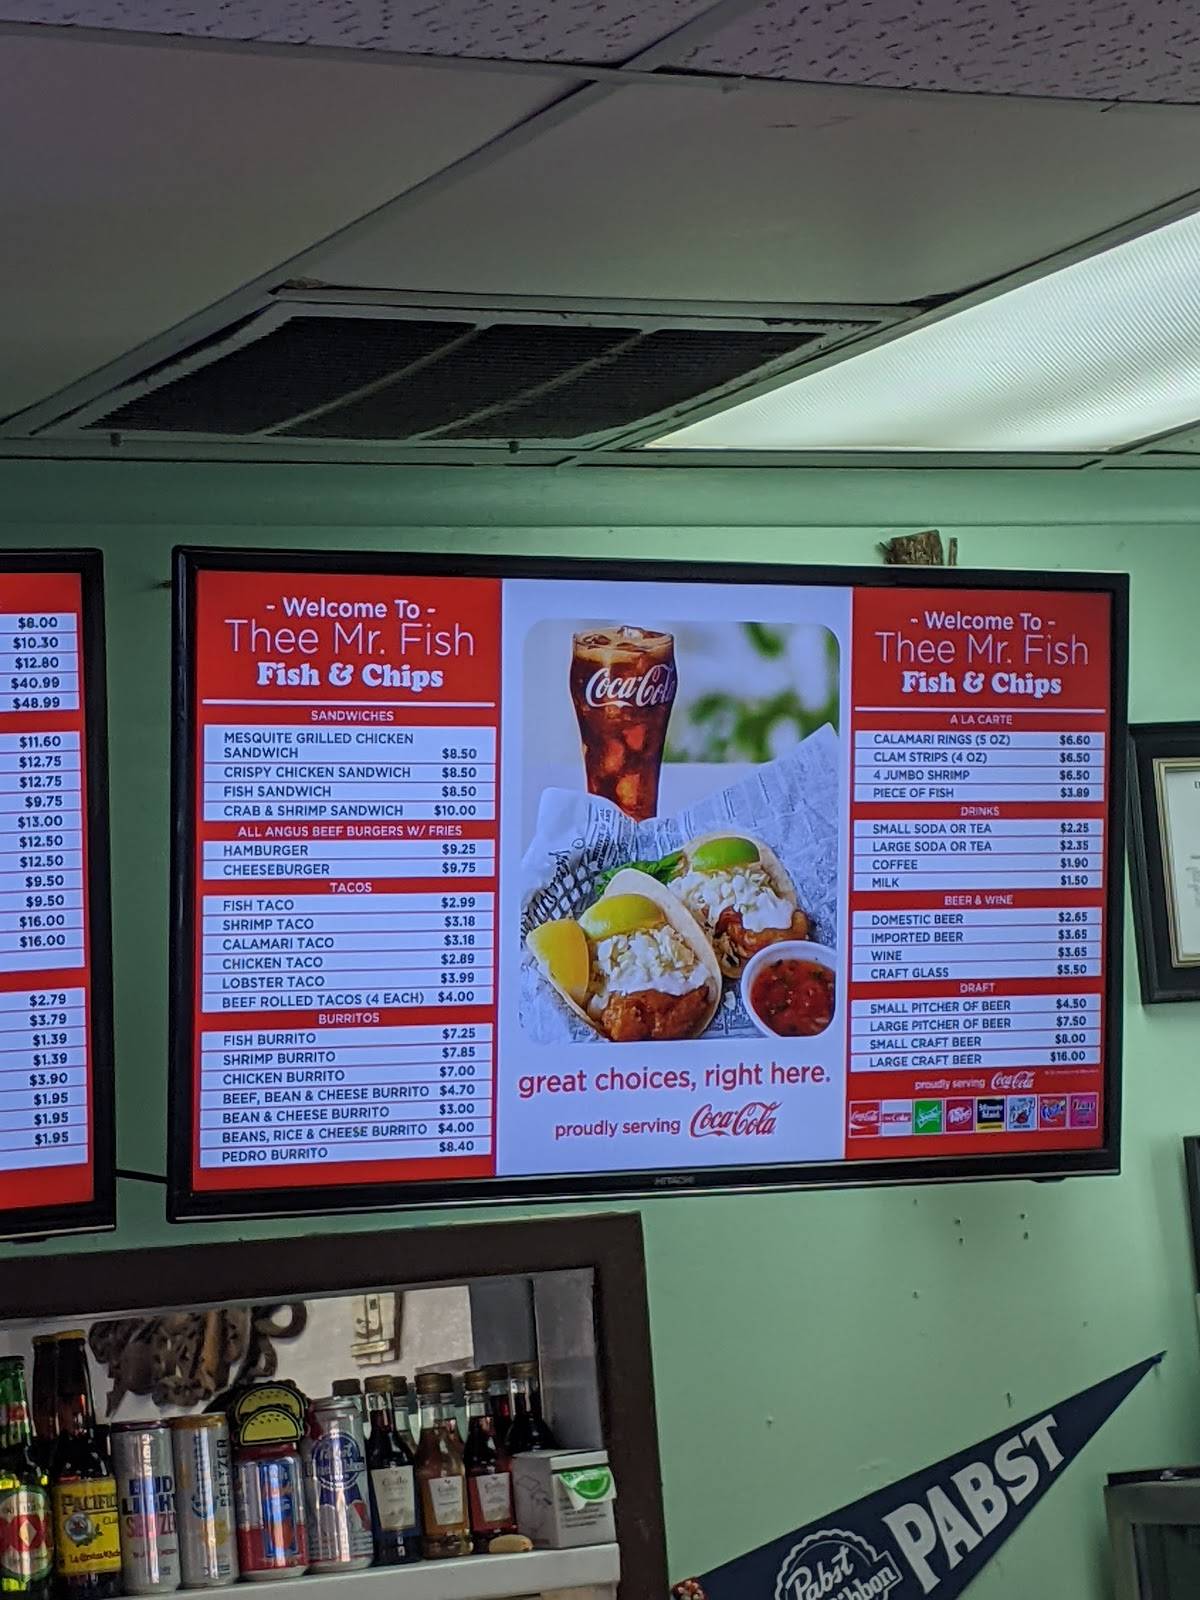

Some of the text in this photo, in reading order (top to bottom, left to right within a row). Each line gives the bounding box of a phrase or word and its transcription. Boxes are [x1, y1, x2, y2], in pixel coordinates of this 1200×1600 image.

[282, 597, 420, 618] Welcome To
[18, 617, 58, 629] $8.00
[925, 611, 1042, 630] Welcome To
[13, 637, 58, 650] $10.30
[224, 618, 474, 656] Thee Mr. Fish
[874, 631, 1089, 665] Thee Mr. Fish
[15, 657, 59, 669] $12.80
[11, 677, 60, 690] $40.99
[256, 662, 444, 692] Fish & Chips
[902, 671, 1062, 698] Fish & Chips
[12, 697, 60, 710] $48.99
[311, 710, 394, 721] SANDWICHES
[950, 715, 1013, 725] A LA CARTE
[19, 736, 61, 749] $11.60
[224, 732, 414, 745] MESQUITE GRILLED CHICKEN
[874, 735, 934, 745] CALAMARI
[938, 735, 972, 745] RINGS
[975, 735, 987, 746] (5
[990, 735, 1010, 746] OZ)
[224, 748, 477, 760] SANDWICH $8.50
[19, 756, 62, 768] $12.75
[224, 766, 476, 778] CRISPY CHICKEN SANDWICH $8.50
[874, 788, 906, 797] PIECE
[909, 788, 926, 797] OF
[929, 788, 954, 797] FISH
[25, 796, 62, 809] $9.75
[224, 805, 476, 816] CRAB & SHRIMP SANDWICH $10.00
[961, 807, 999, 816] DRINKS
[18, 816, 63, 829] $13.00
[873, 824, 911, 834] SMALL
[914, 824, 946, 834] SODA
[950, 824, 967, 834] OR
[970, 824, 992, 833] TEA
[238, 826, 462, 838] ALL ANGUS BEEF BURGERS W/ FRIES
[19, 836, 63, 849] $12.50
[224, 844, 476, 856] HAMBURGER $9.25
[224, 862, 476, 876] CHEESEBURGER $9.75
[873, 860, 918, 870] COFFEE
[25, 875, 64, 888] $9.50
[330, 882, 372, 892] TACOS
[872, 877, 899, 888] MILK
[224, 897, 476, 911] FISH TACO $2.99
[944, 895, 1013, 906] BEER & WINE
[20, 915, 65, 928] $16.00
[223, 916, 476, 930] SHRIMP TACO $3.18
[872, 915, 931, 926] DOMESTIC
[934, 914, 964, 924] BEER
[223, 954, 475, 970] CHICKEN TACO $2.89
[222, 972, 474, 988] LOBSTER TACO $3.99
[871, 969, 908, 979] CRAFT
[912, 968, 949, 978] GLASS
[960, 983, 995, 993] DRAFT
[29, 994, 66, 1006] $2.79
[222, 992, 474, 1008] BEEF ROLLED TACOS (4 EACH) $4.00
[870, 1003, 908, 1014] SMALL
[912, 1002, 959, 1013] PITCHER
[963, 1001, 978, 1011] OF
[982, 1000, 1010, 1010] BEER
[29, 1014, 66, 1026] $3.79
[318, 1013, 380, 1024] BURRITOS
[33, 1034, 67, 1046] $1.39
[224, 1028, 476, 1046] FISH BURRITO $7.25
[870, 1039, 908, 1049] SMALL
[911, 1038, 948, 1048] CRAFT
[952, 1036, 981, 1047] BEER
[29, 1073, 68, 1086] $3.90
[518, 1062, 831, 1099] great choices, right here.
[34, 1093, 68, 1105] $1.95
[223, 1084, 475, 1106] BEEF, BEAN & CHEESE BURRITO $4.70
[222, 1122, 474, 1144] BEANS, RICE & CHEESE BURRITO $4.00
[555, 1119, 618, 1140] proudly
[622, 1117, 681, 1134] serving
[222, 1140, 474, 1162] PEDRO BURRITO $8.40
[882, 1414, 1064, 1594] PABST
[785, 1545, 854, 1600] Pabst
